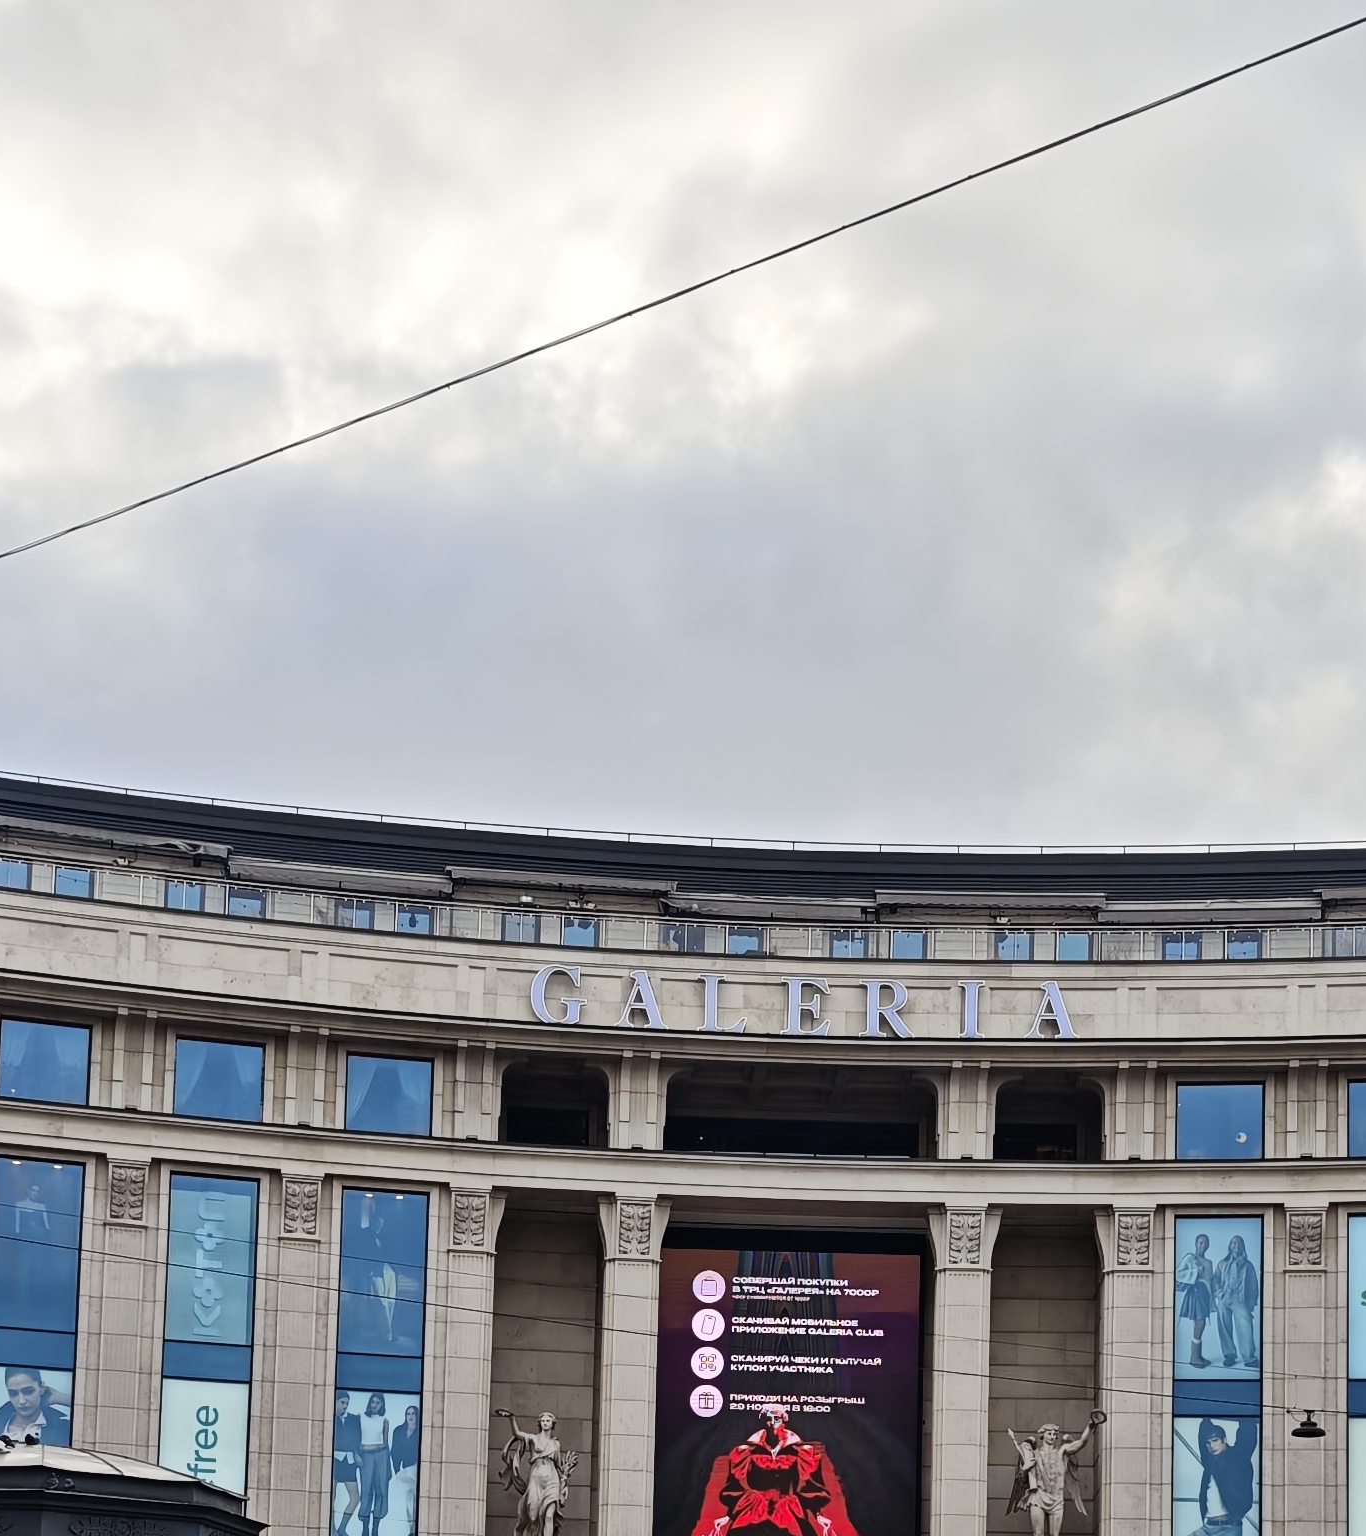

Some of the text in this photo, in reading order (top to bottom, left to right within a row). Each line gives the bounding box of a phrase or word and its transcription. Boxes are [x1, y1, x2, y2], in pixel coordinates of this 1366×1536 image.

[530, 963, 1080, 1040] GALERIA
[732, 1276, 849, 1287] СОВЕРШАЙ ПОКУПКИ
[742, 1286, 766, 1295] ТРЦ
[826, 1288, 842, 1296] НА
[731, 1316, 859, 1327] СКАЧИВАЙ МОБИЛЬНОЕ
[731, 1326, 807, 1335] ПРИЛОЖЕНИЕ
[855, 1329, 884, 1337] CLUB
[730, 1354, 789, 1364] СКАНИРУЙ
[791, 1356, 819, 1365] ЧЕКИ
[830, 1357, 882, 1366] ПОЛУЧАЙ
[730, 1364, 834, 1374] КУПОН УЧАСТНИКА
[729, 1394, 781, 1402] ПРИХОДИ
[800, 1396, 866, 1404] РОЗЫГРЫШ
[186, 1404, 220, 1486] free
